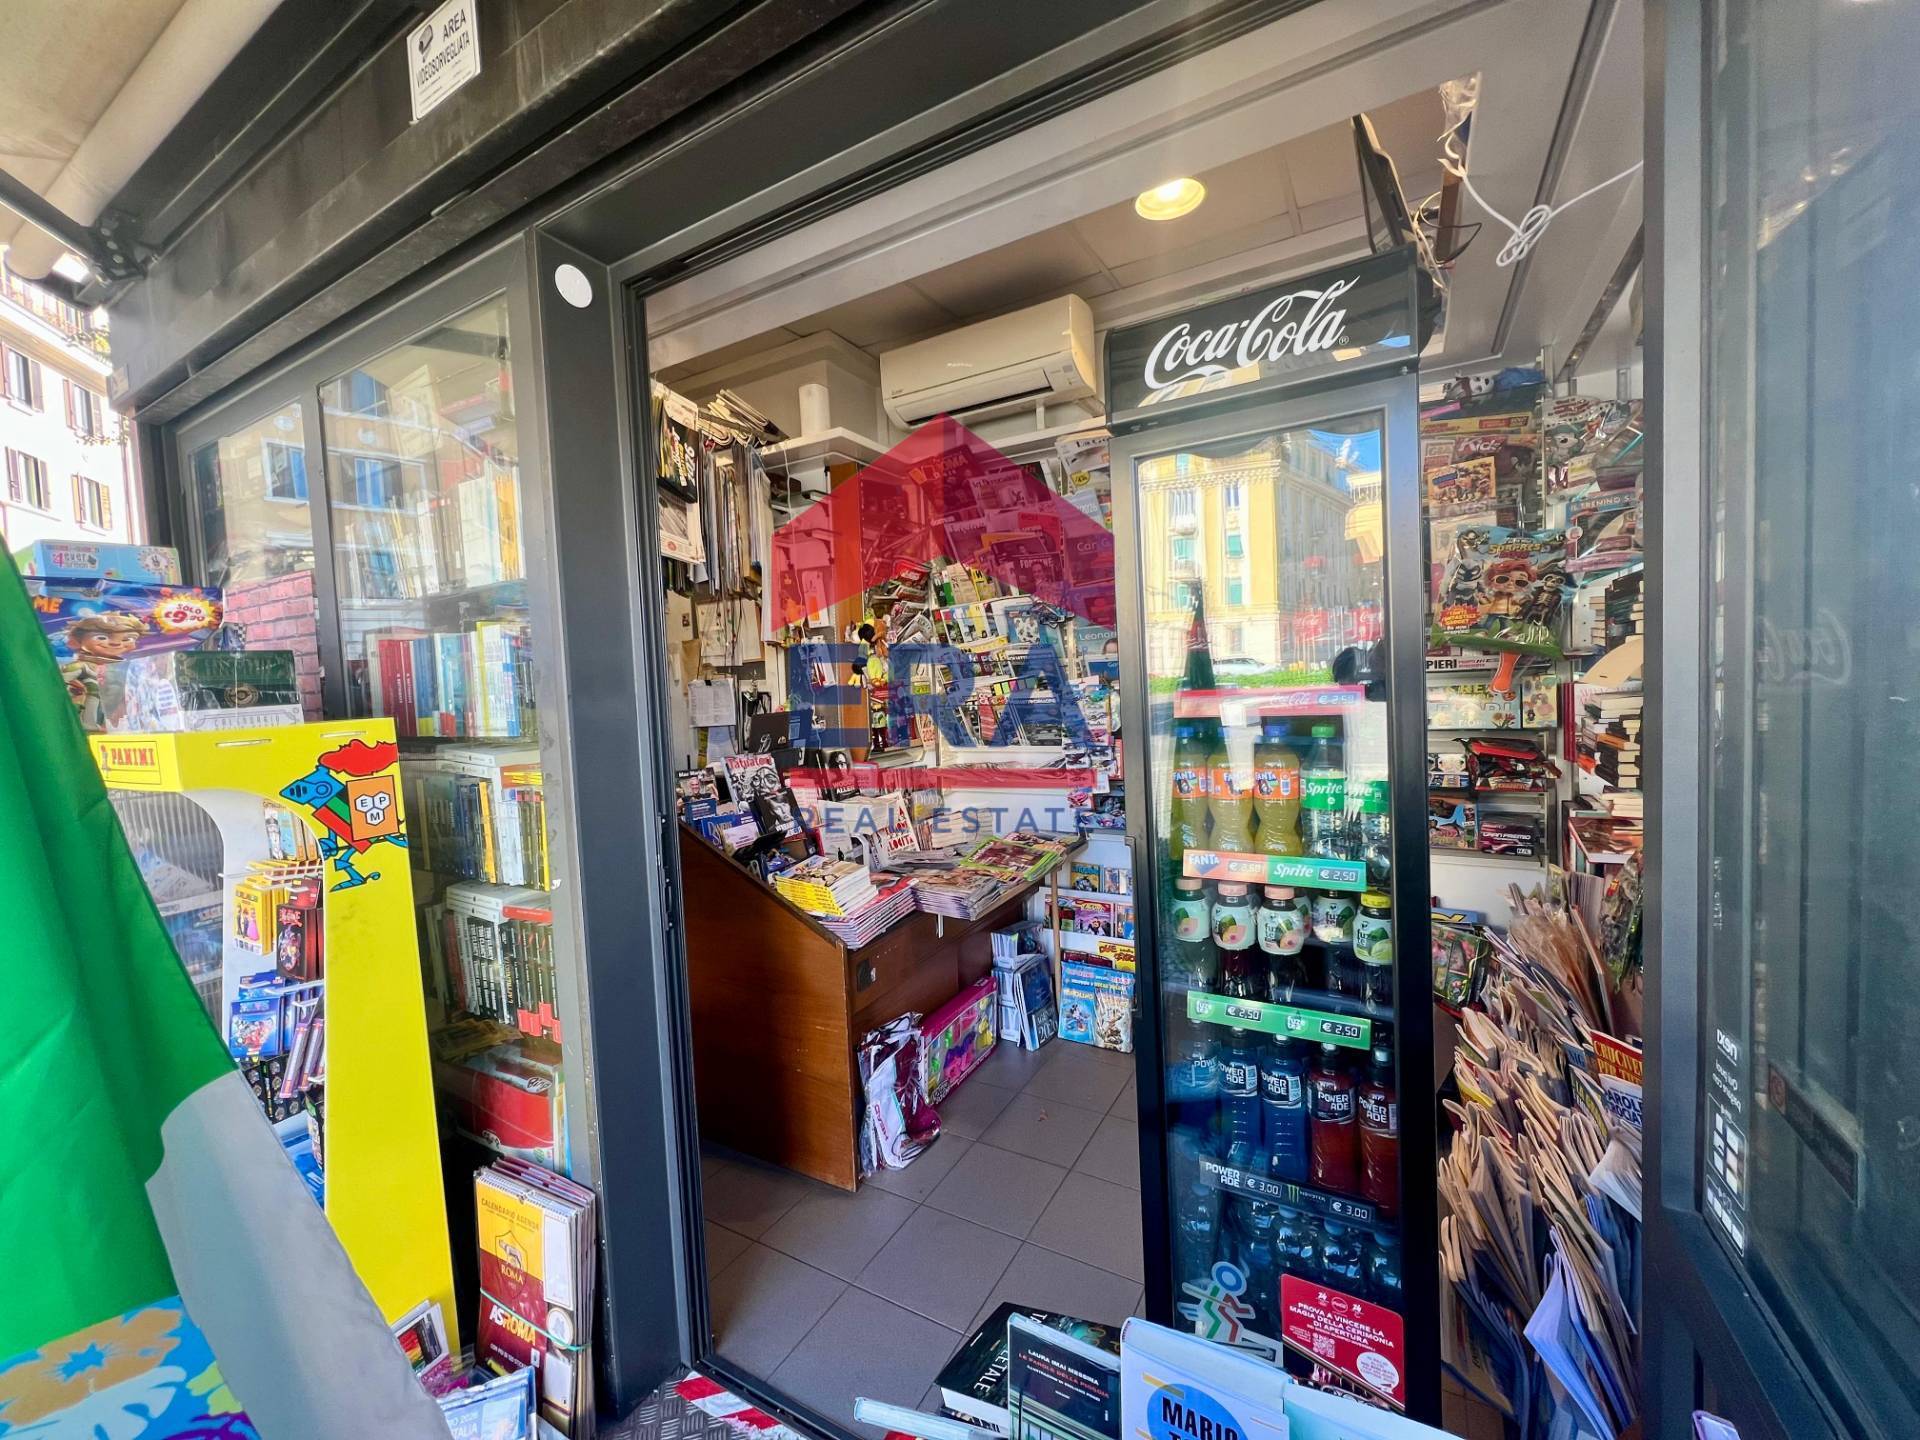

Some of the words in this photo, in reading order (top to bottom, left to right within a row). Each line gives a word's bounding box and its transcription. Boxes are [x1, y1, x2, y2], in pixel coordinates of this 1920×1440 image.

[443, 9, 466, 41] AREA
[416, 30, 470, 88] VIDEOSORVEGLIATA
[1144, 275, 1360, 389] Coca-Cola
[176, 603, 202, 615] SOLO
[111, 748, 155, 766] PANINI
[1306, 783, 1343, 797] Sprite
[1189, 854, 1220, 866] FANTA
[1274, 863, 1314, 878] Sprite
[1333, 870, 1357, 882] 2.50
[1238, 1008, 1260, 1020] 2.50
[1335, 1024, 1358, 1037] 2.50
[1226, 1074, 1245, 1085] ADE
[1268, 1083, 1287, 1096] ADE
[1318, 1091, 1349, 1105] POWER
[1330, 1101, 1350, 1112] ADE
[1366, 1110, 1388, 1123] ADE
[1221, 1175, 1240, 1188] ADE
[1206, 1162, 1240, 1180] POWER
[1259, 1181, 1279, 1195] 3.00
[1346, 1205, 1368, 1219] 3.00
[501, 1263, 525, 1286] ROMA
[1289, 1305, 1316, 1320] MAGIA
[1317, 1316, 1344, 1331] DELLA
[1345, 1326, 1395, 1348] CERIMONIA
[1298, 1302, 1325, 1317] PROVA
[1335, 1315, 1371, 1333] VINCERE
[1372, 1329, 1385, 1338] LA
[1323, 1325, 1369, 1346] APERTURA
[1027, 1349, 1050, 1363] LAURA
[1051, 1358, 1067, 1371] IMAI
[1067, 1366, 1100, 1387] MESSINA
